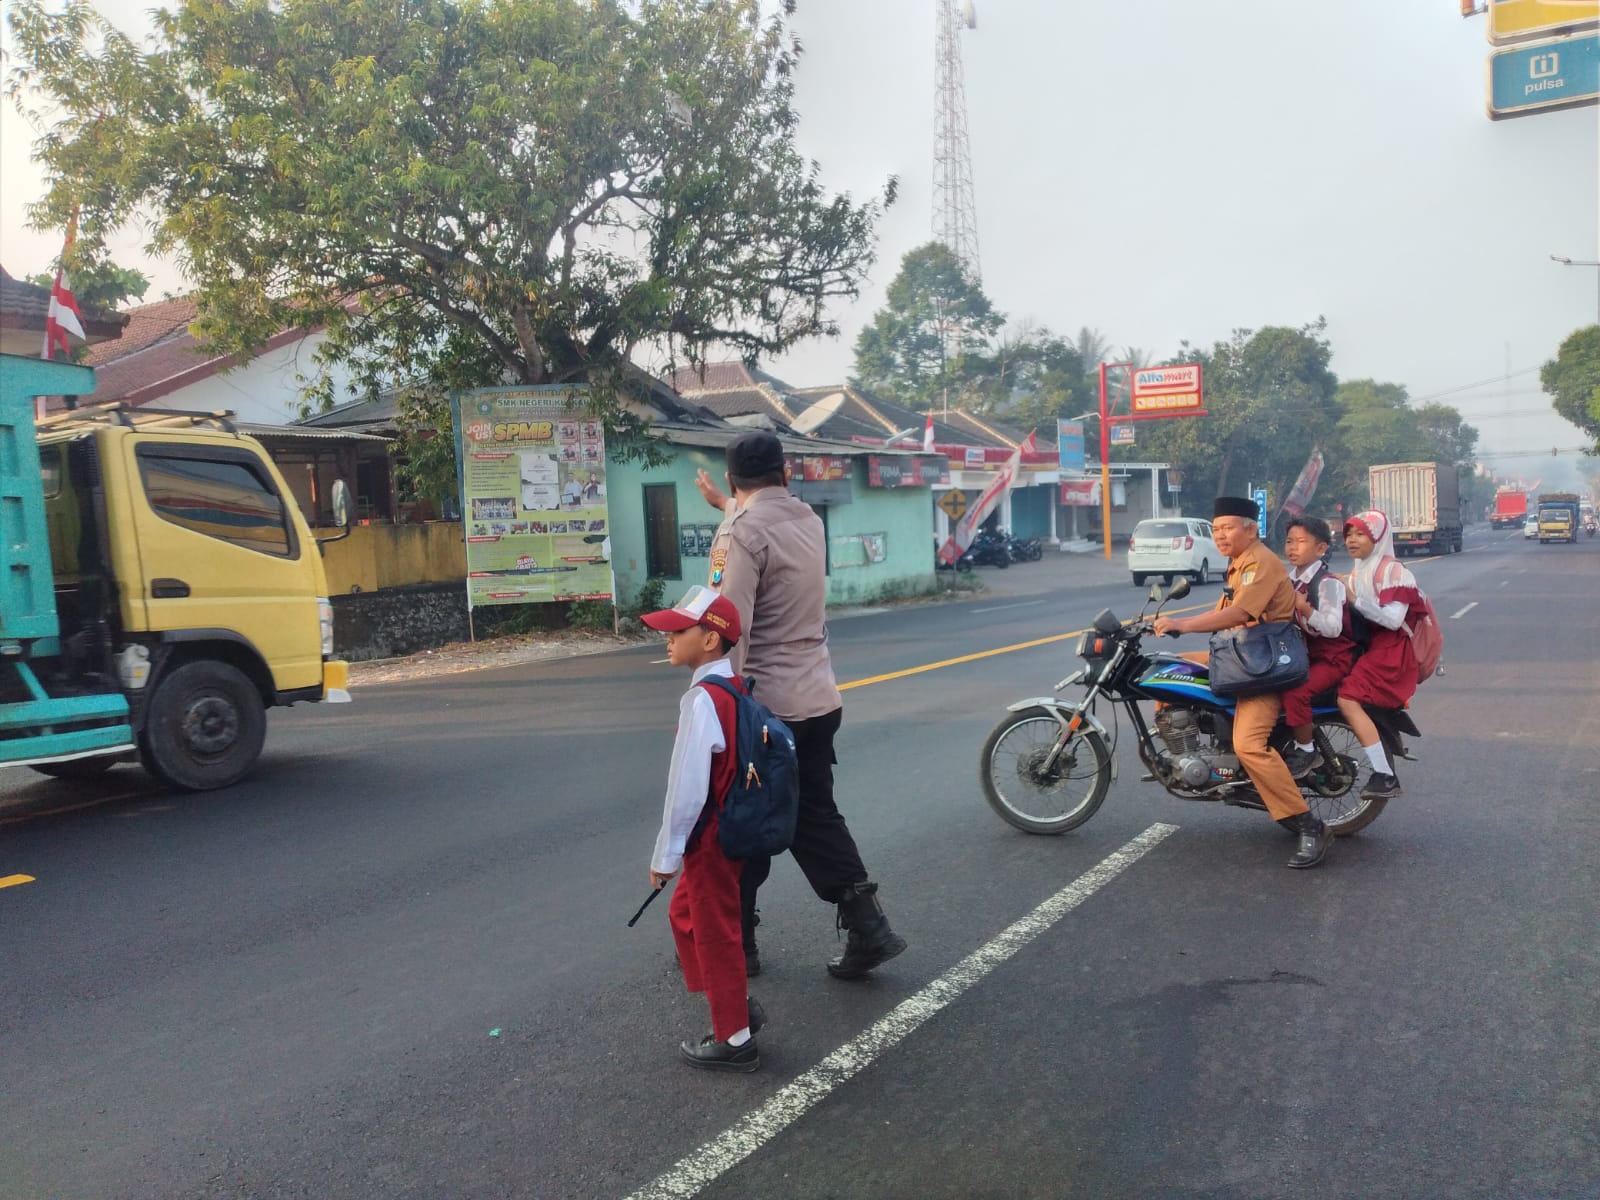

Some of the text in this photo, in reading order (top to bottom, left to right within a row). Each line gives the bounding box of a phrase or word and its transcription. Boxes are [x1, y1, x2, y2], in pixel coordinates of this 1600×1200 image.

[1524, 78, 1564, 96] pulsa
[496, 399, 517, 408] SMK
[519, 399, 553, 407] NEGERI
[466, 423, 491, 434] JOIN
[494, 421, 553, 441] SPMB
